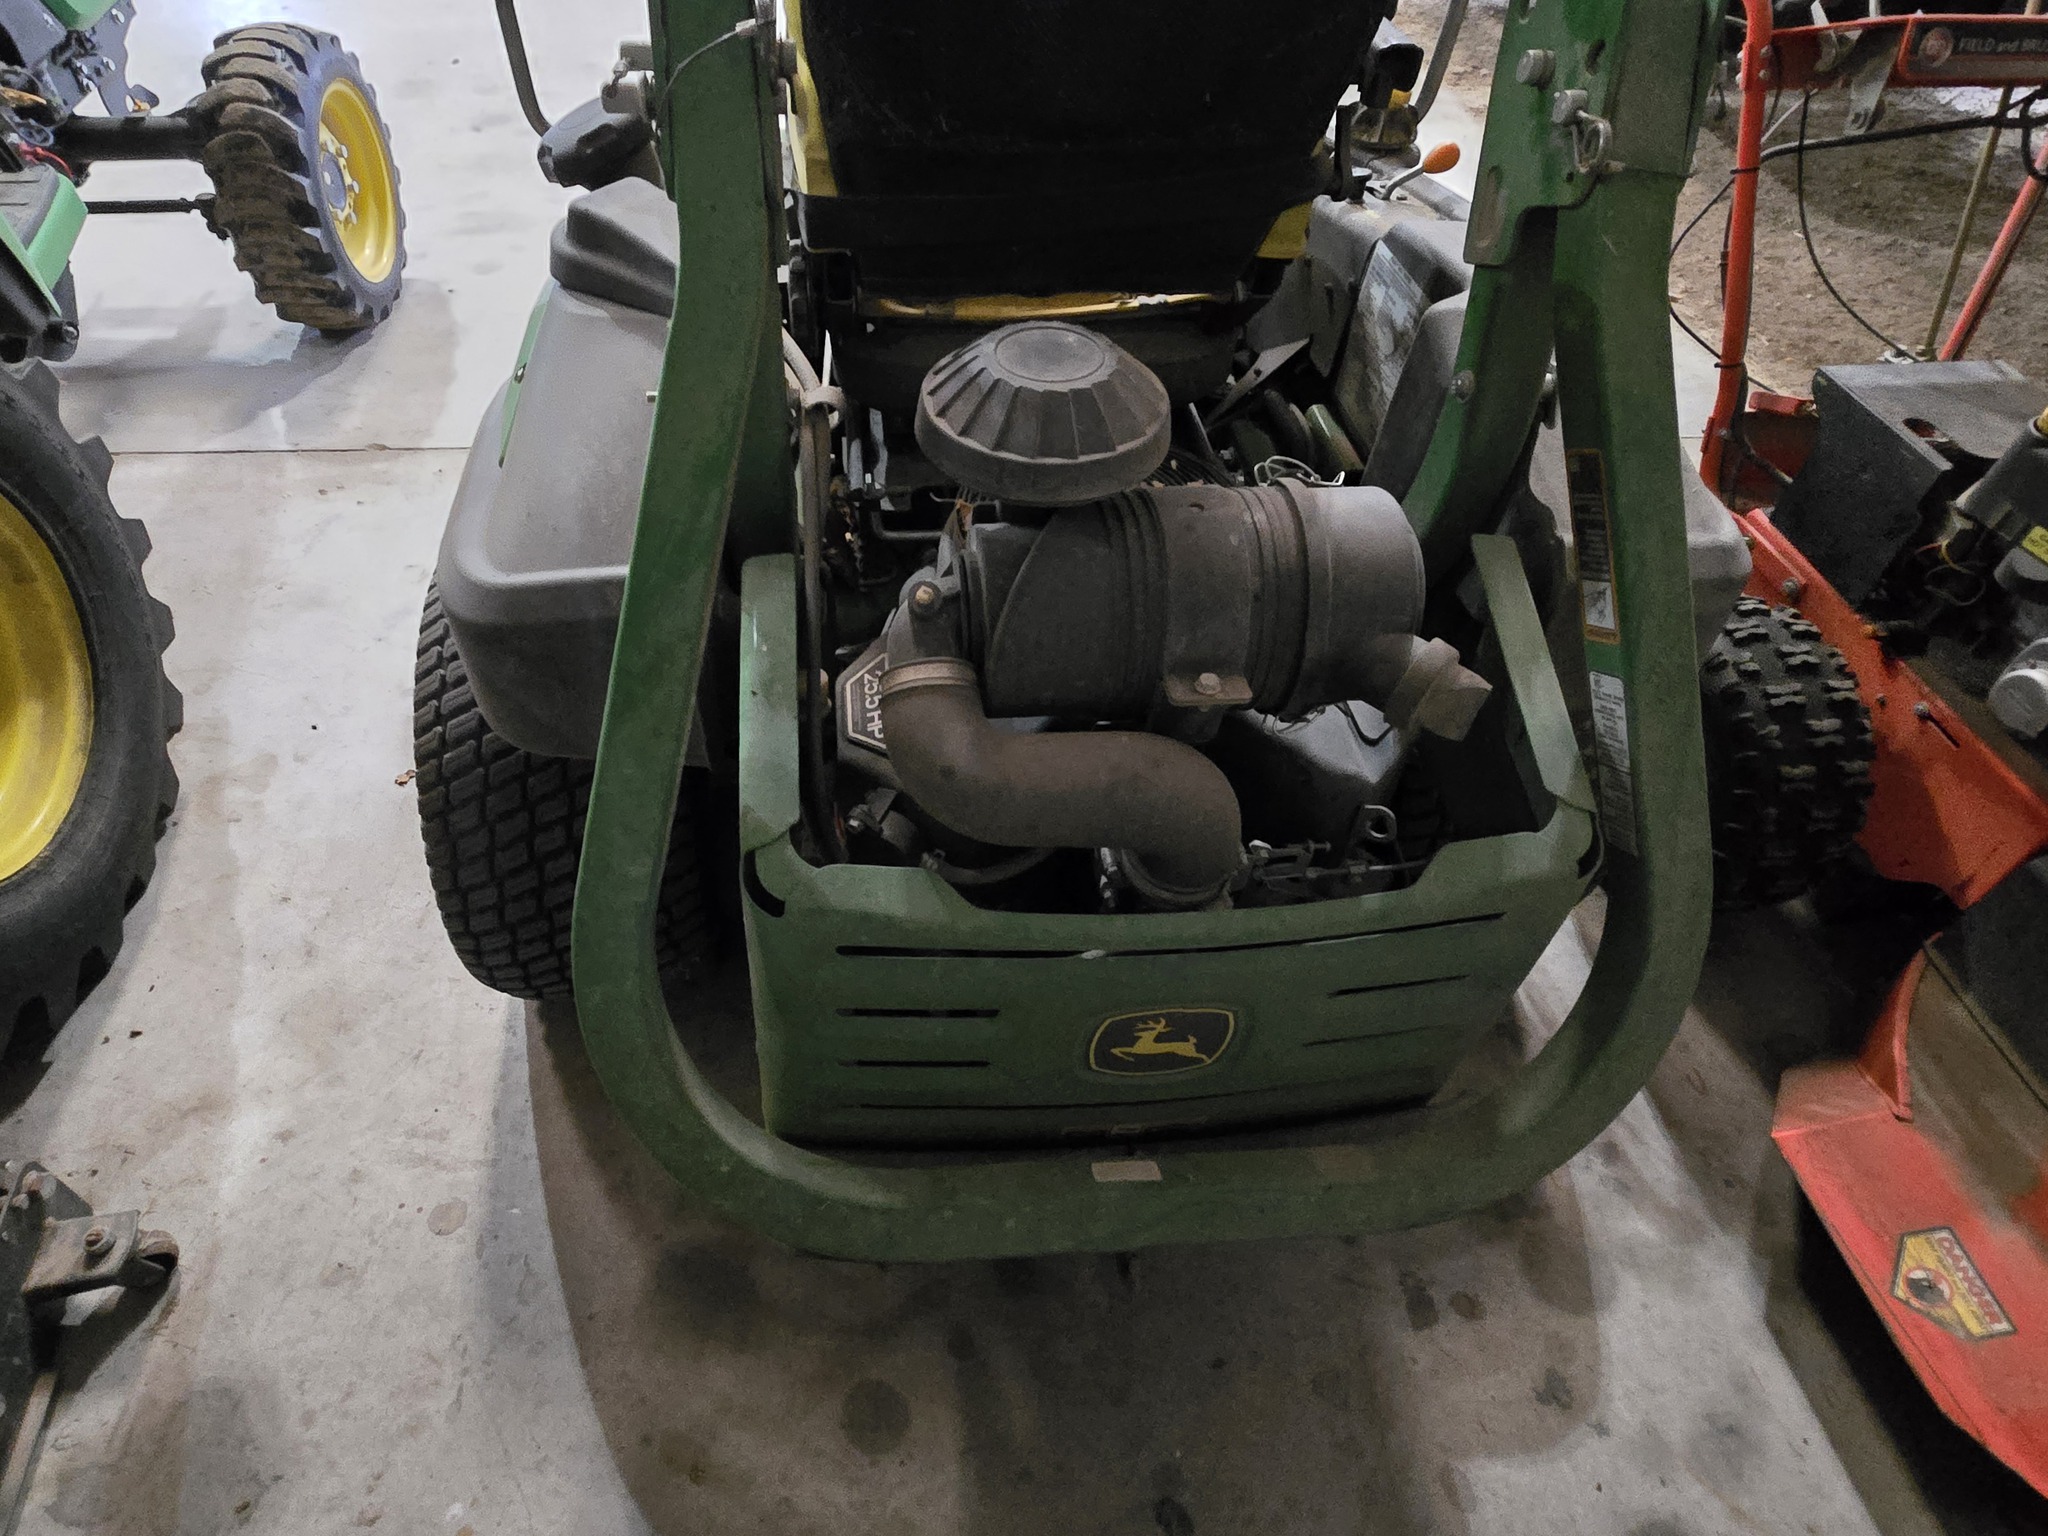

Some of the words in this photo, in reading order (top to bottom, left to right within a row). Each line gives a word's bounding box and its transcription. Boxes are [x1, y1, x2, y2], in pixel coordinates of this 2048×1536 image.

[1958, 37, 1996, 52] FIELD
[1996, 38, 2020, 52] and
[866, 709, 884, 739] HP
[1936, 1236, 2004, 1325] DANGER
